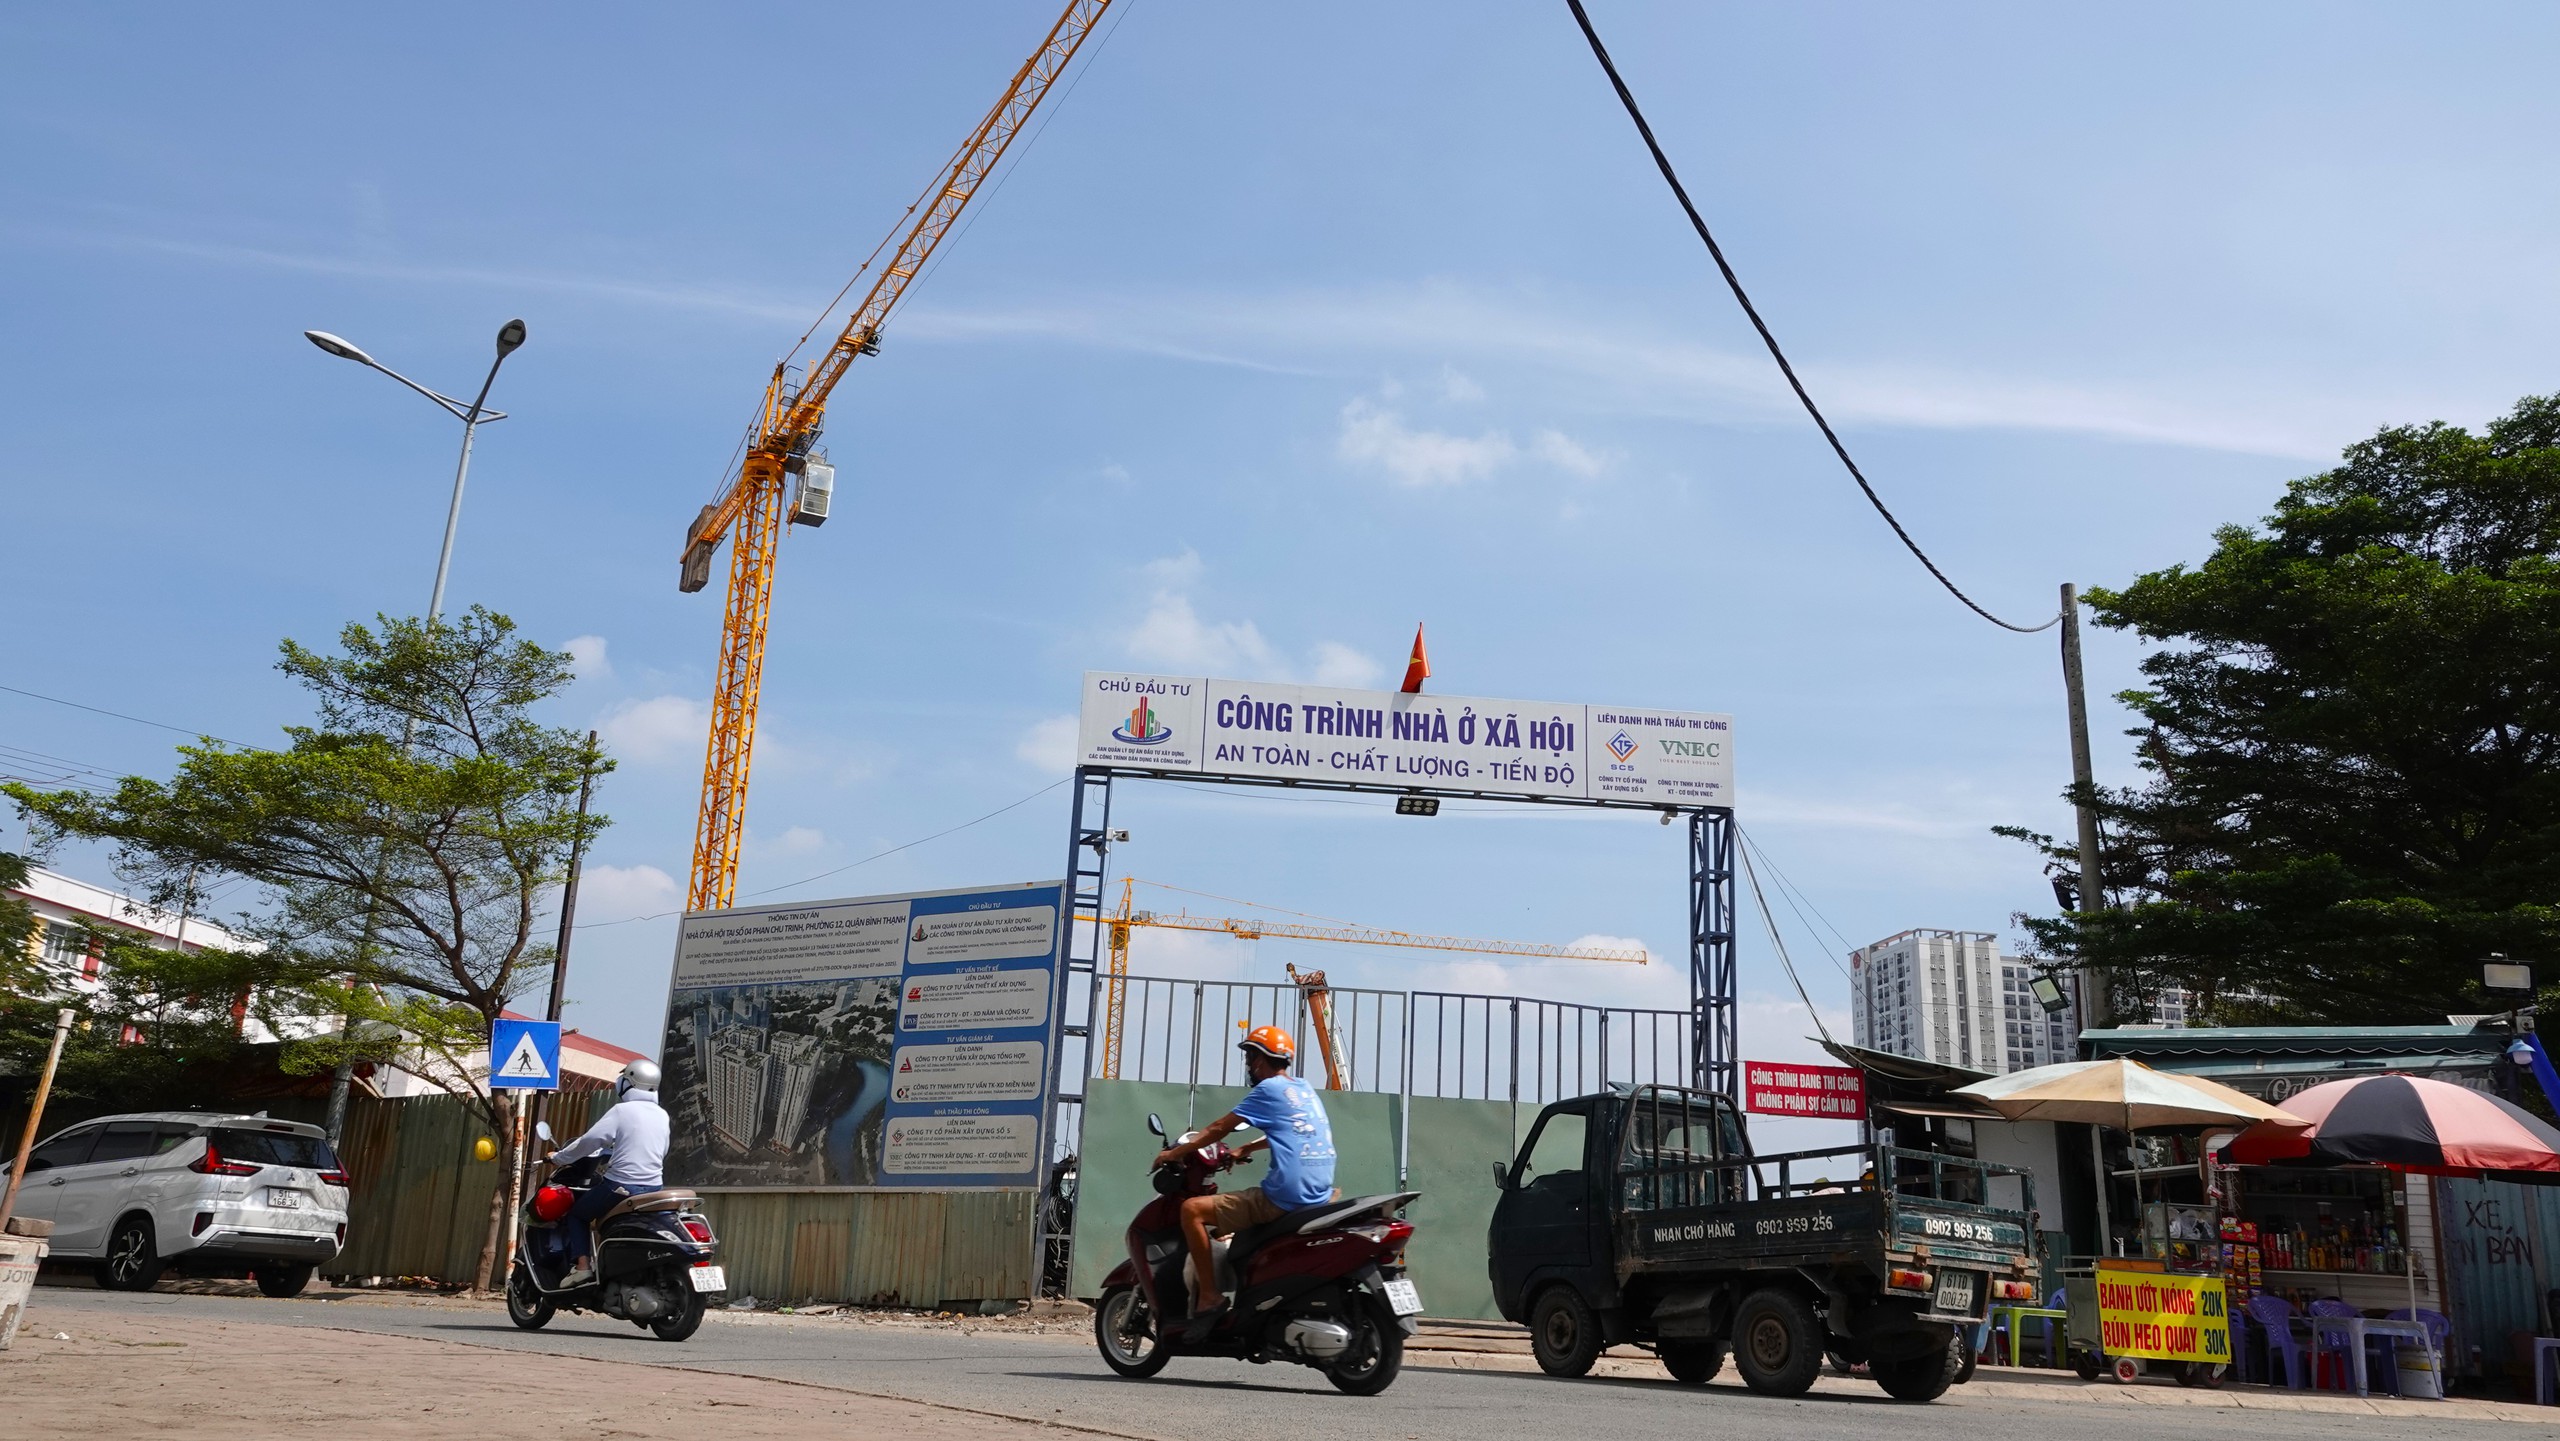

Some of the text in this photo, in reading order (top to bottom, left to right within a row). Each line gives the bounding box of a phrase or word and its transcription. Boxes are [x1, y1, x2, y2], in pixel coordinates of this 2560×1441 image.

[1099, 677, 1191, 696] CHỦ ĐẦU TƯ
[1217, 695, 1574, 757] CÔNG TRÌNH NHÀ Ở XÃ HỘI
[1598, 713, 1727, 730] LIÊN DANH NHÀ THẦU THI CÔNG
[1659, 740, 1720, 757] VNEC
[1215, 744, 1244, 762] AN
[1252, 744, 1309, 766] TOÀN
[1331, 747, 1388, 772] CHẤT
[1396, 756, 1469, 779] LƯỢNG
[1490, 757, 1536, 782] TIẾN
[1544, 762, 1574, 788] ĐỘ
[768, 914, 788, 922] THÔNG
[940, 930, 955, 938] CÔNG
[1751, 1068, 1859, 1091] CÔNG TRÌNH ĐANG THI CÔNG
[1756, 1090, 1856, 1114] KHÔNG PHẬN SỰ CẤM VÀO
[278, 1190, 292, 1198] 51L
[1707, 1220, 1735, 1238] HÀNG
[1756, 1220, 1783, 1236] 0902
[1812, 1215, 1833, 1231] 256
[2464, 1200, 2503, 1230] XE
[1926, 1219, 1993, 1241] 0902 969 256
[1306, 1237, 1344, 1247] LEAD
[2486, 1226, 2534, 1268] BÁN
[2100, 1278, 2224, 1317] BÁNH ƯỚT NÓNG 20K
[2103, 1316, 2227, 1355] BÚN HEO QUAY 30K
